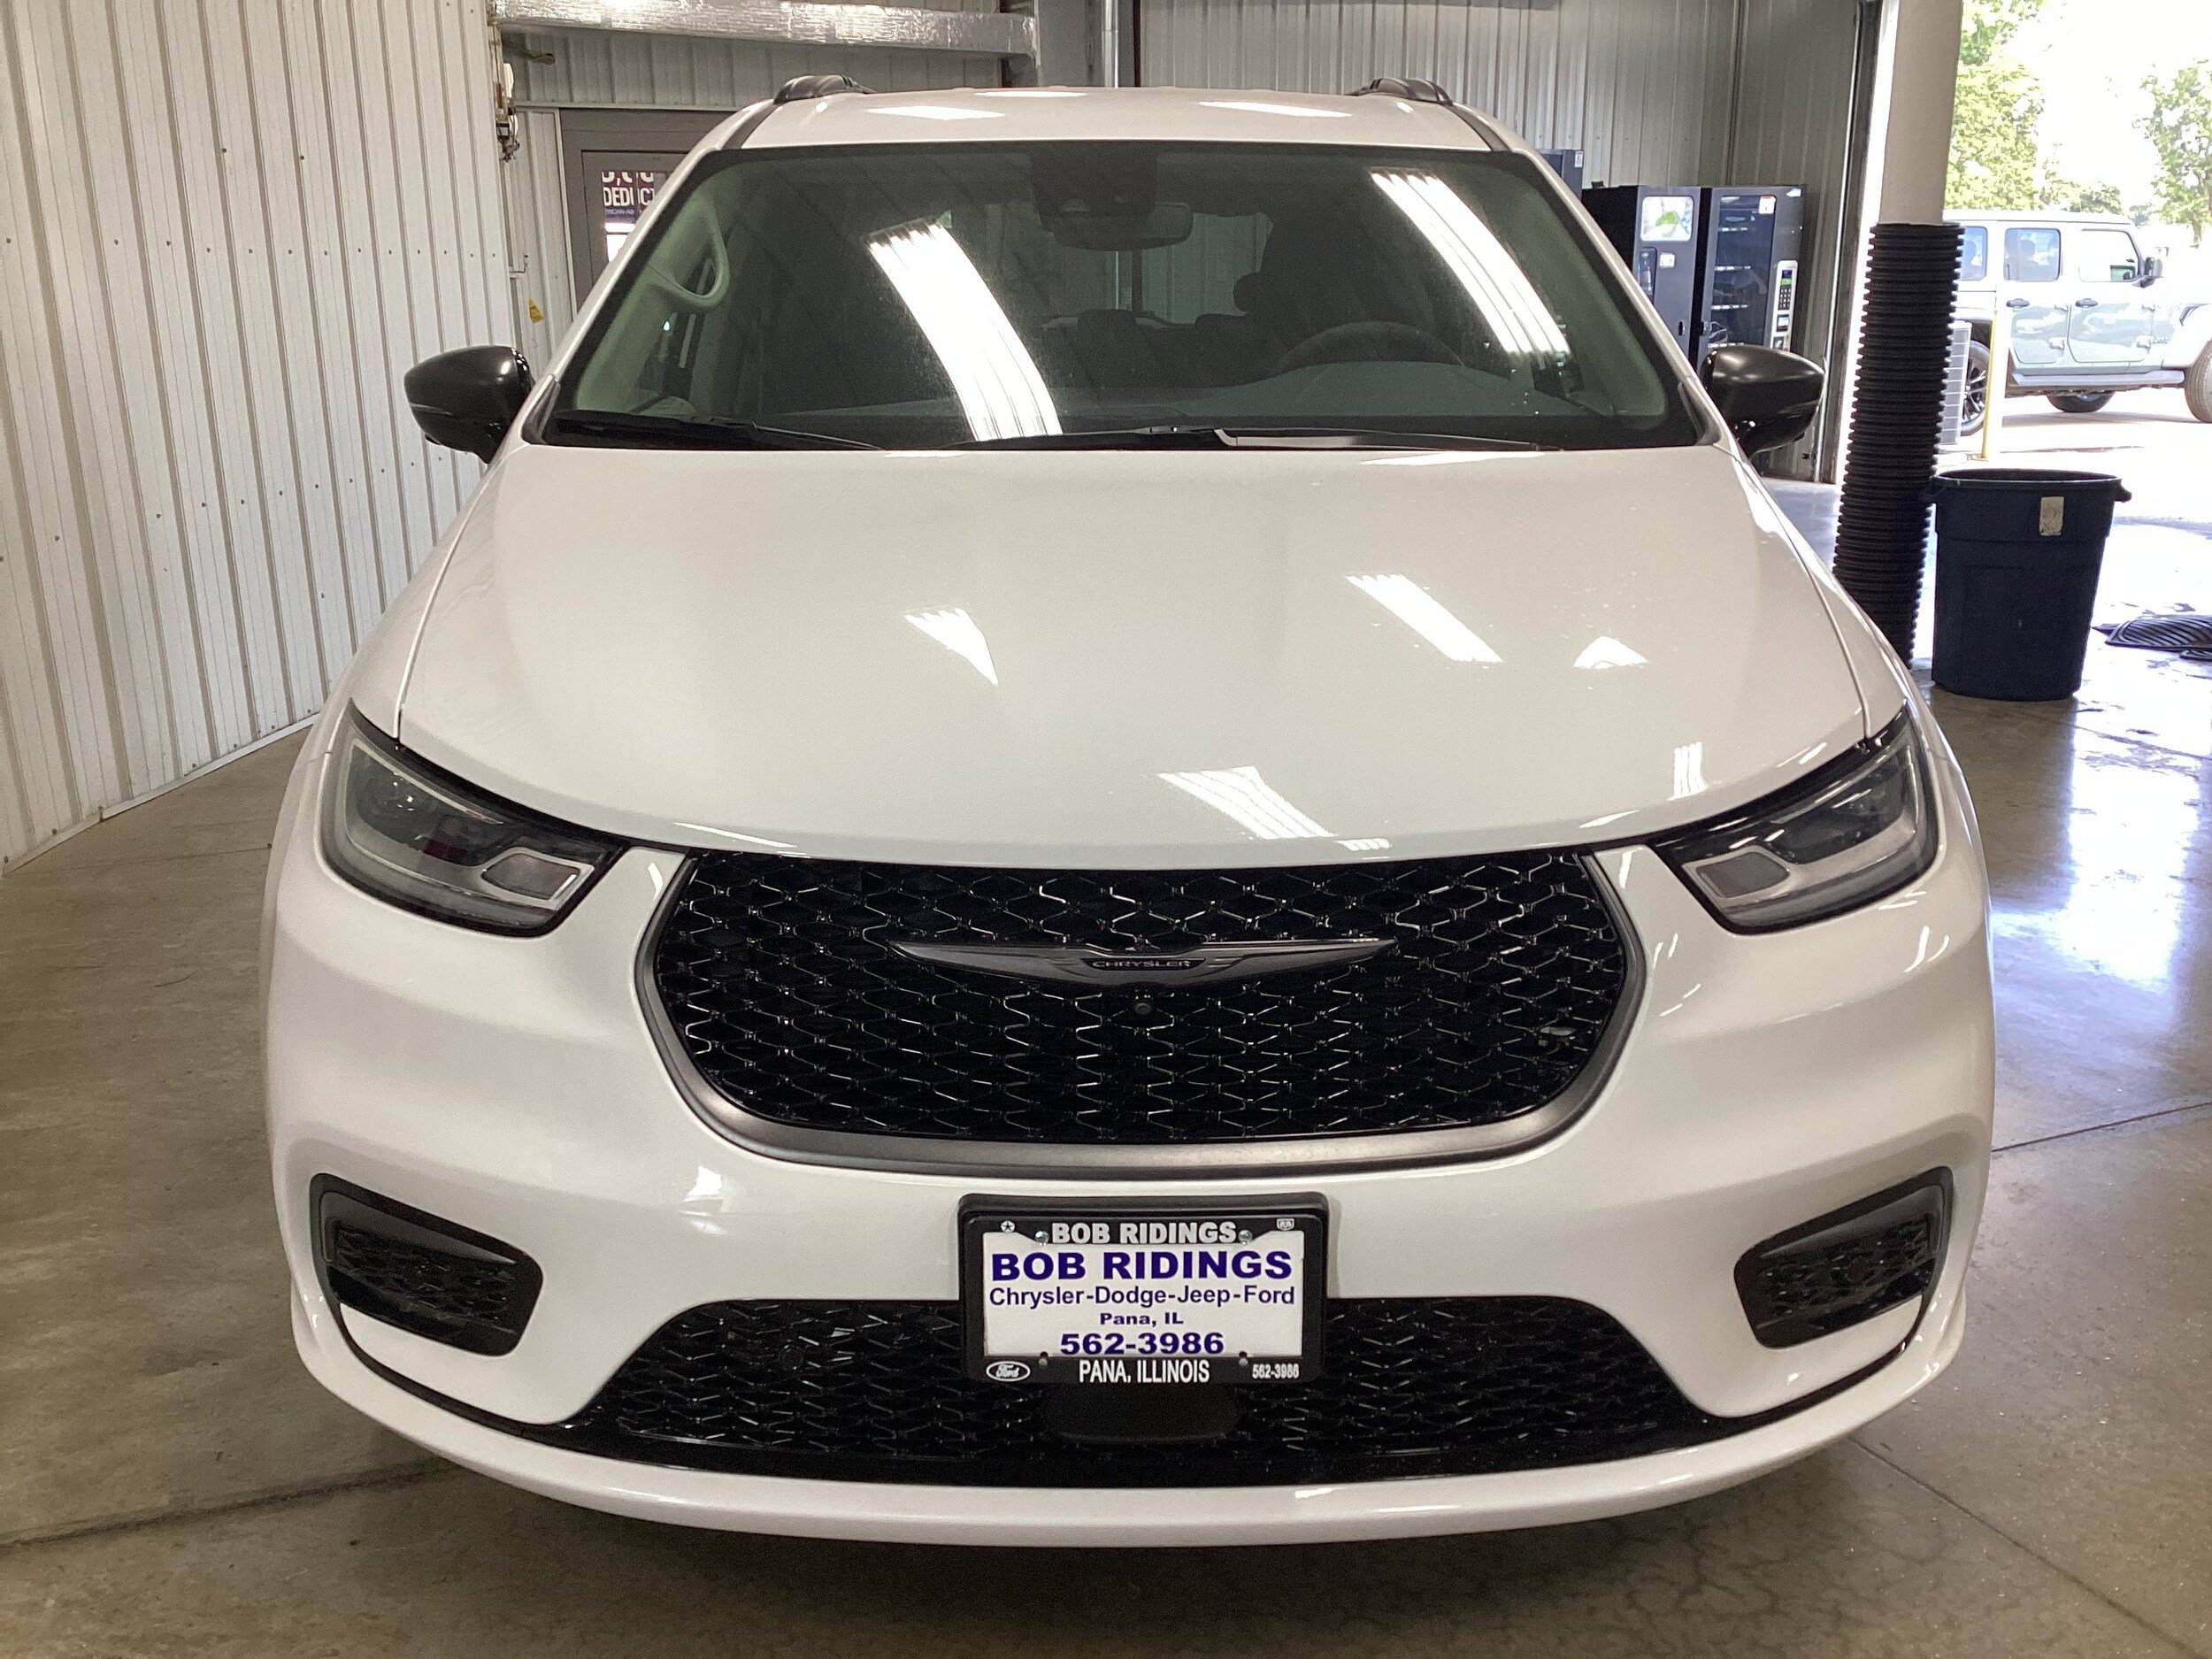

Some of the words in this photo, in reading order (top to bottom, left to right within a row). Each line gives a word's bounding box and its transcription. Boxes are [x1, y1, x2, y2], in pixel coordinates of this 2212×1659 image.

[1092, 960, 1191, 969] CHRYSLER
[1051, 1222, 1110, 1244] BOB
[1119, 1221, 1237, 1244] RIDINGS
[992, 1251, 1087, 1281] BOB
[1103, 1250, 1292, 1280] RIDINGS
[989, 1285, 1295, 1310] Chrysler-Dodge-Jeep-Ford
[1100, 1312, 1157, 1326] Pana,
[1164, 1312, 1184, 1325] IL
[1061, 1333, 1225, 1356] 562-3986
[995, 1363, 1020, 1379] Ford
[1079, 1359, 1132, 1384] PANA,
[1137, 1359, 1210, 1384] ILLINOIS
[1252, 1363, 1300, 1379] 562-3986
